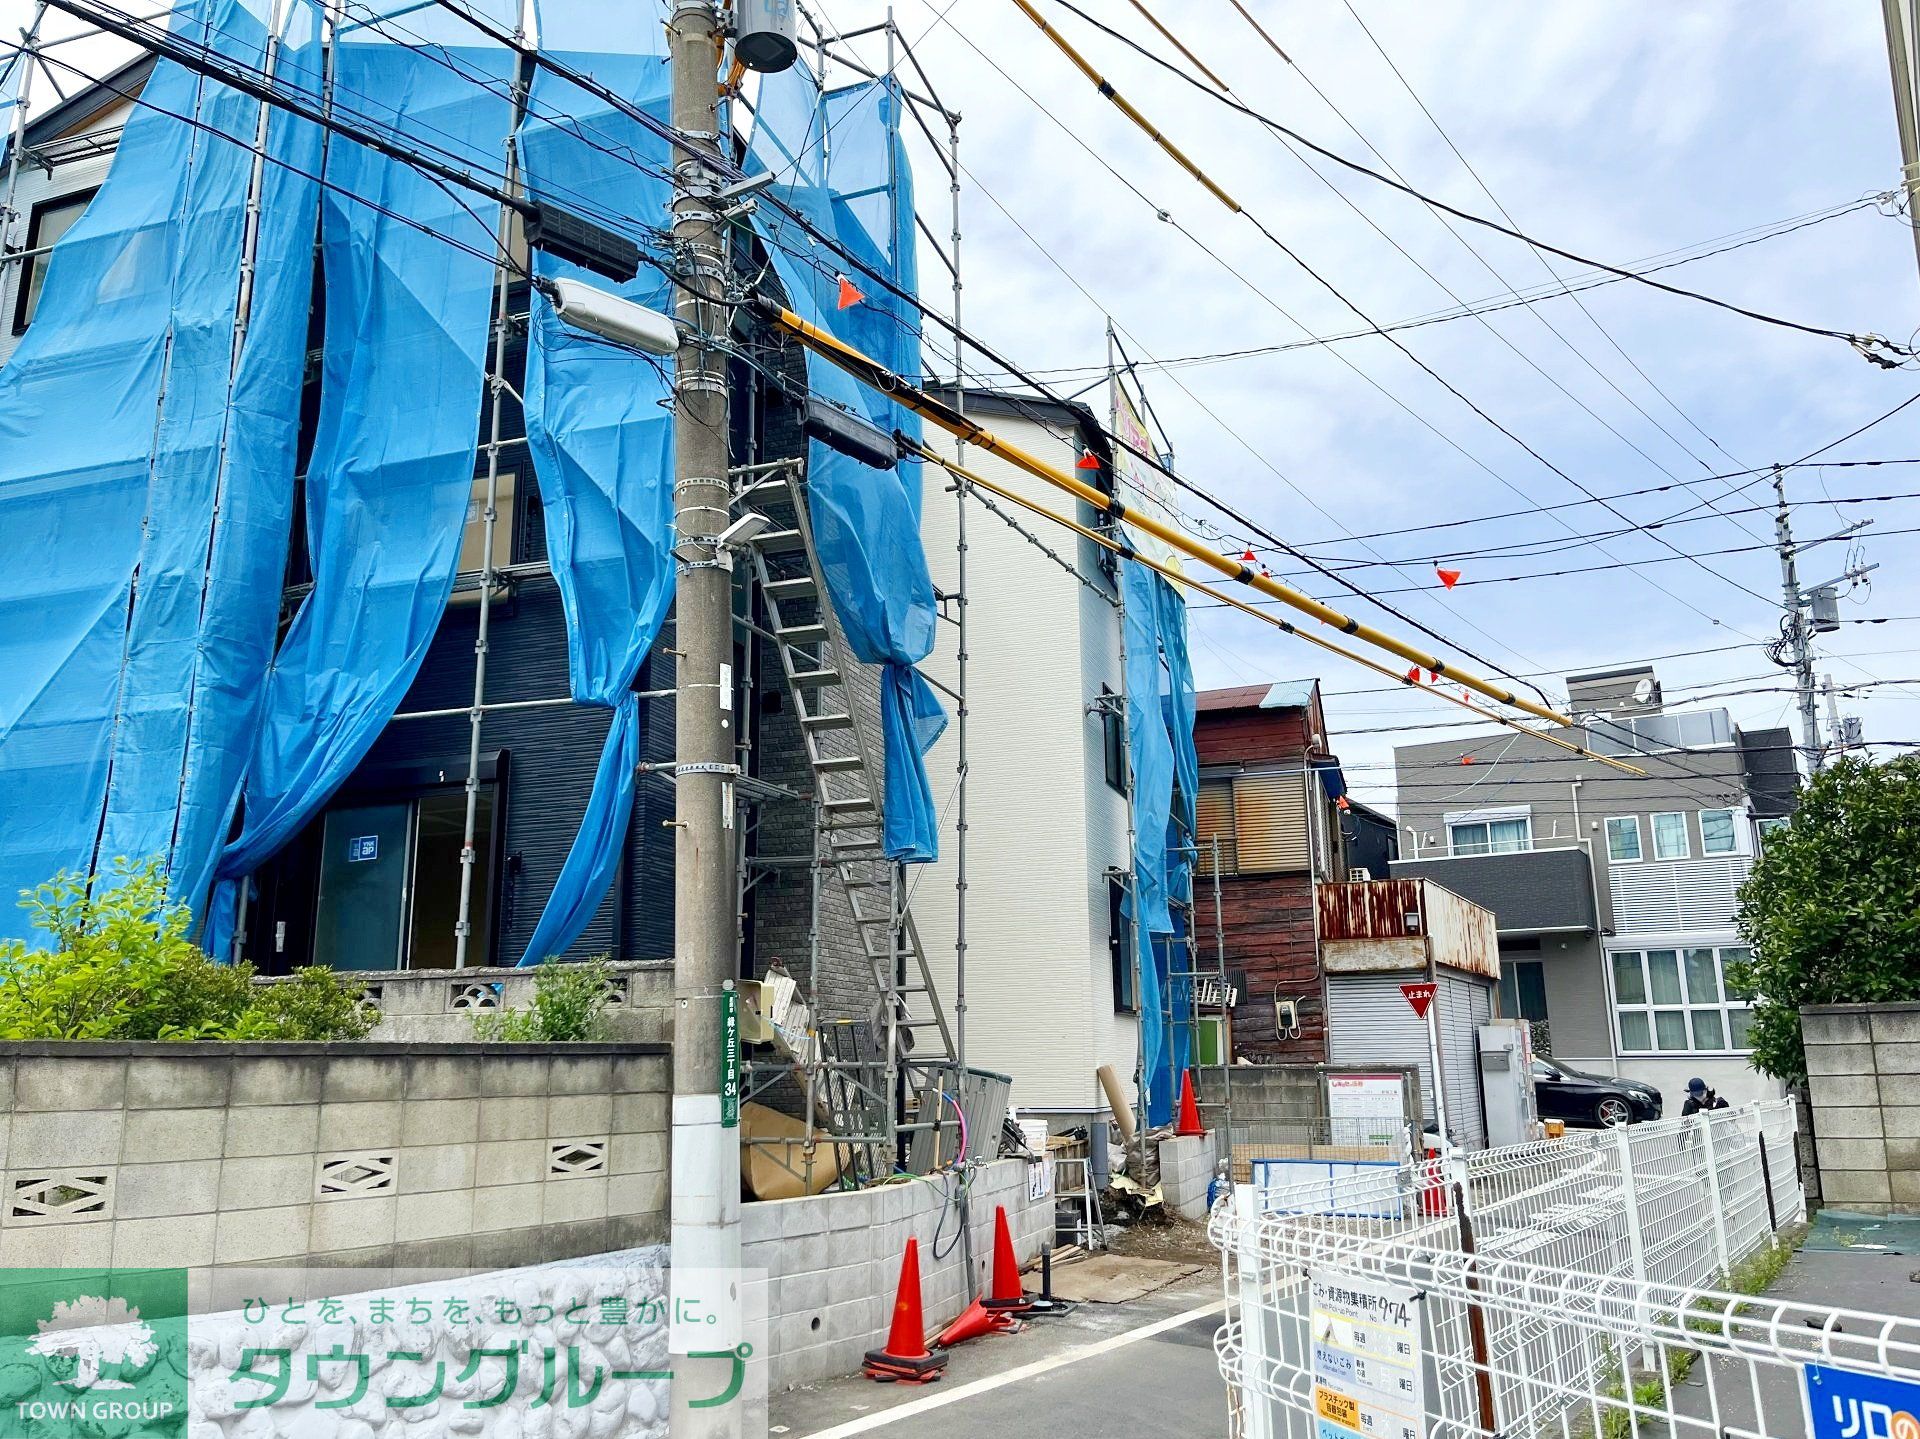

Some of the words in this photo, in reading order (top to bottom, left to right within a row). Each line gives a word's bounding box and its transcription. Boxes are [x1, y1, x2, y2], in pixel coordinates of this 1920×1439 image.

[362, 846, 374, 855] ap
[1408, 990, 1431, 999] 止まれ
[725, 1082, 736, 1096] 34
[1313, 1283, 1377, 1311] ごみ・資源物集積所
[1379, 1296, 1412, 1328] 974
[1354, 1331, 1366, 1343] 毎週
[1397, 1342, 1410, 1355] 曜日
[1399, 1378, 1413, 1392] 曜日
[1318, 1390, 1355, 1412] プラスチック製
[1361, 1412, 1373, 1427] 毎週
